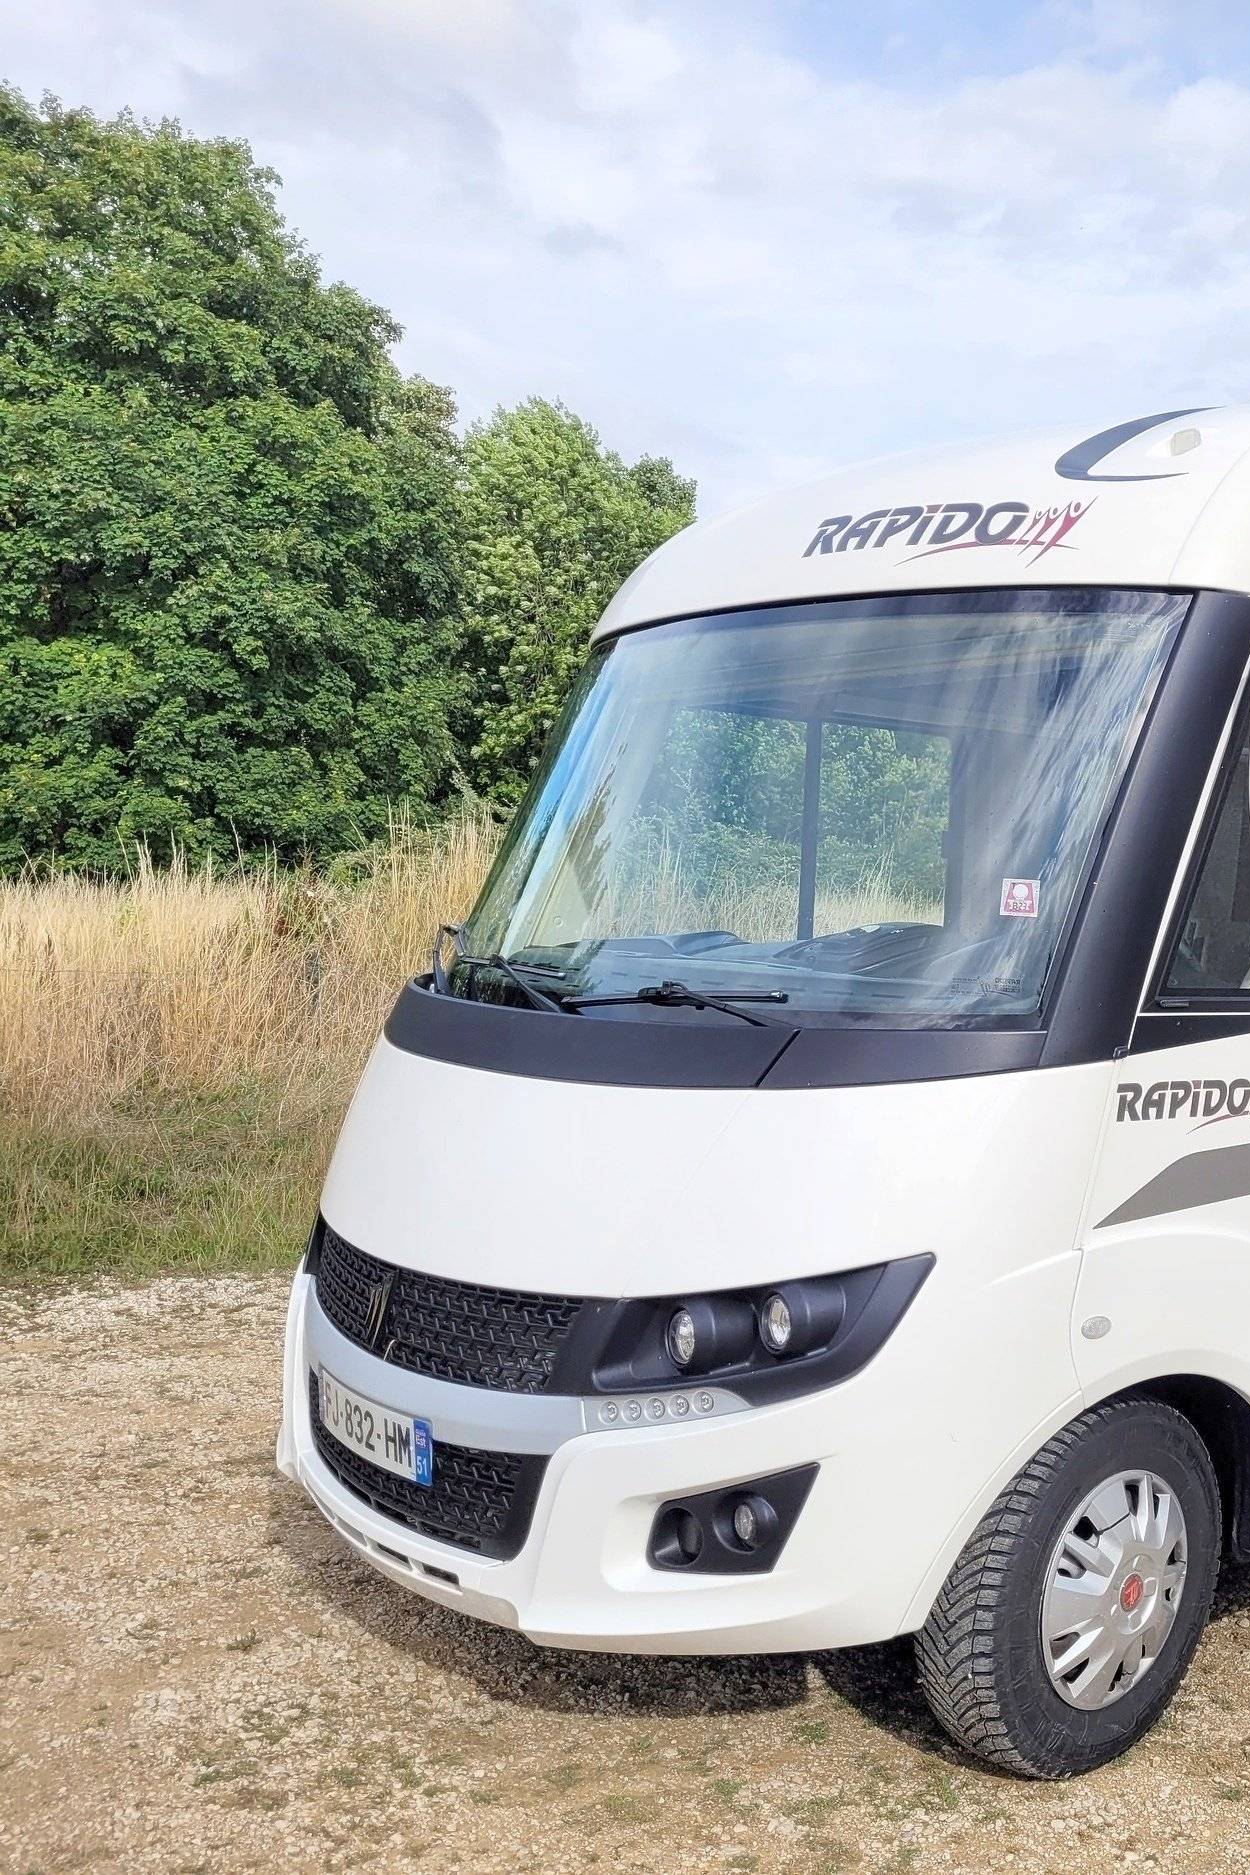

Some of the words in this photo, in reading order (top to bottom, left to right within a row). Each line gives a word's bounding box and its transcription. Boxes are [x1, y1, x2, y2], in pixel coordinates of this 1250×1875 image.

[801, 501, 1031, 559] RAPIDO
[324, 1380, 412, 1468] FJ-832-HM
[415, 1455, 427, 1476] 51
